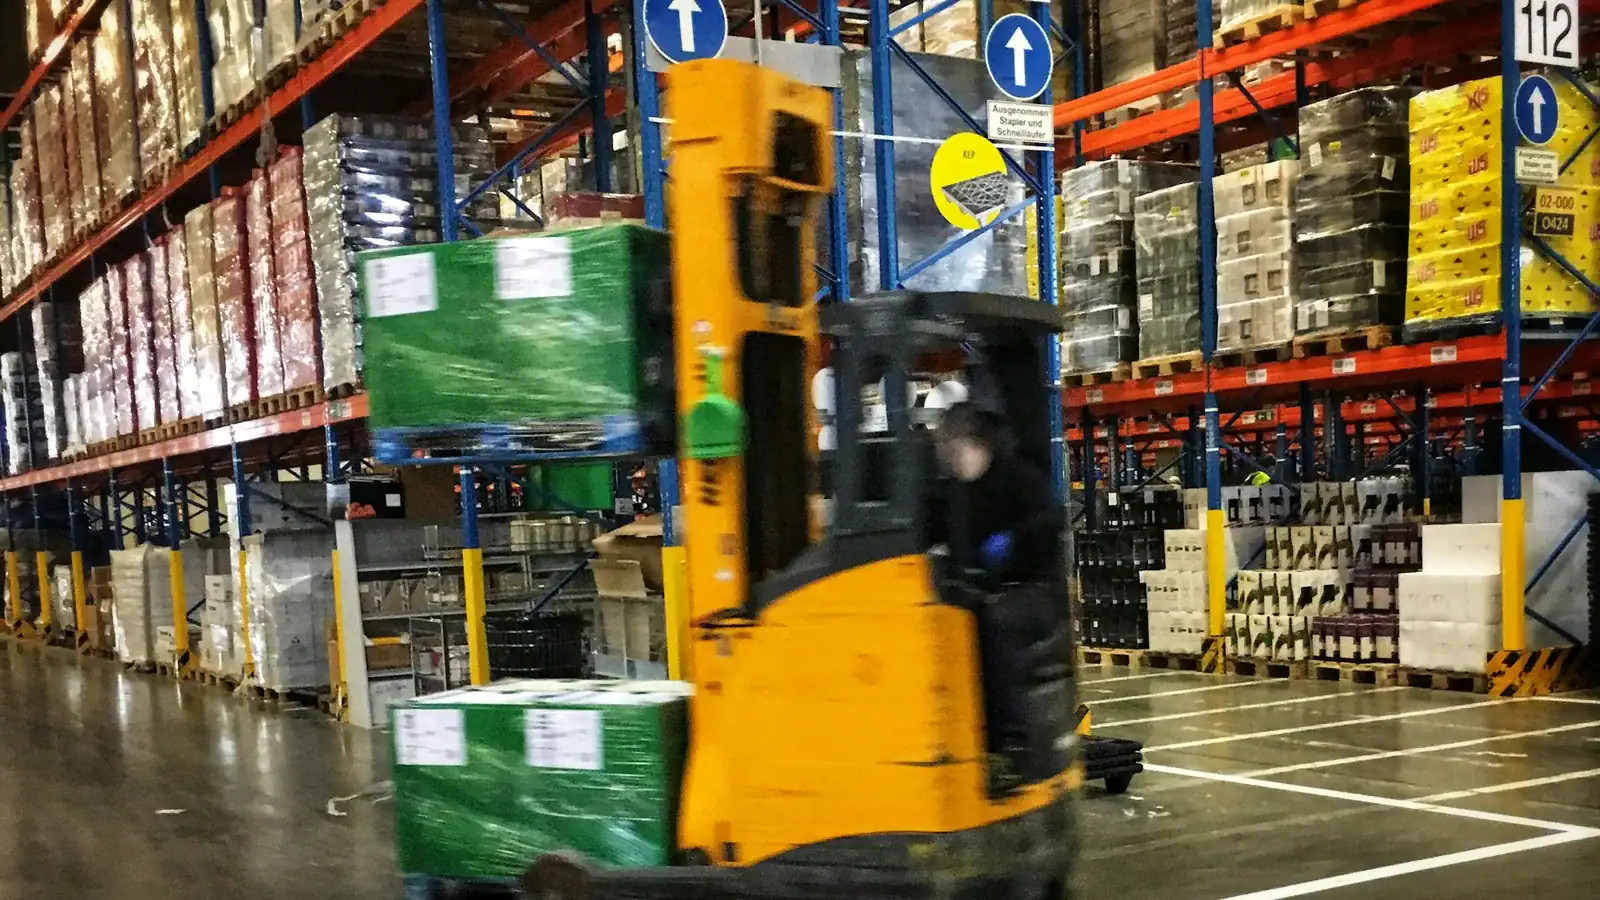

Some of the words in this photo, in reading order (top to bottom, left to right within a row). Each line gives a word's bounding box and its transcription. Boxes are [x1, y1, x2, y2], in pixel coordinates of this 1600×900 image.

[1522, 0, 1572, 59] 112
[992, 105, 1049, 117] Ausgenommen
[999, 116, 1026, 128] Stapler
[1028, 119, 1043, 128] und
[1540, 194, 1575, 210] 02-000
